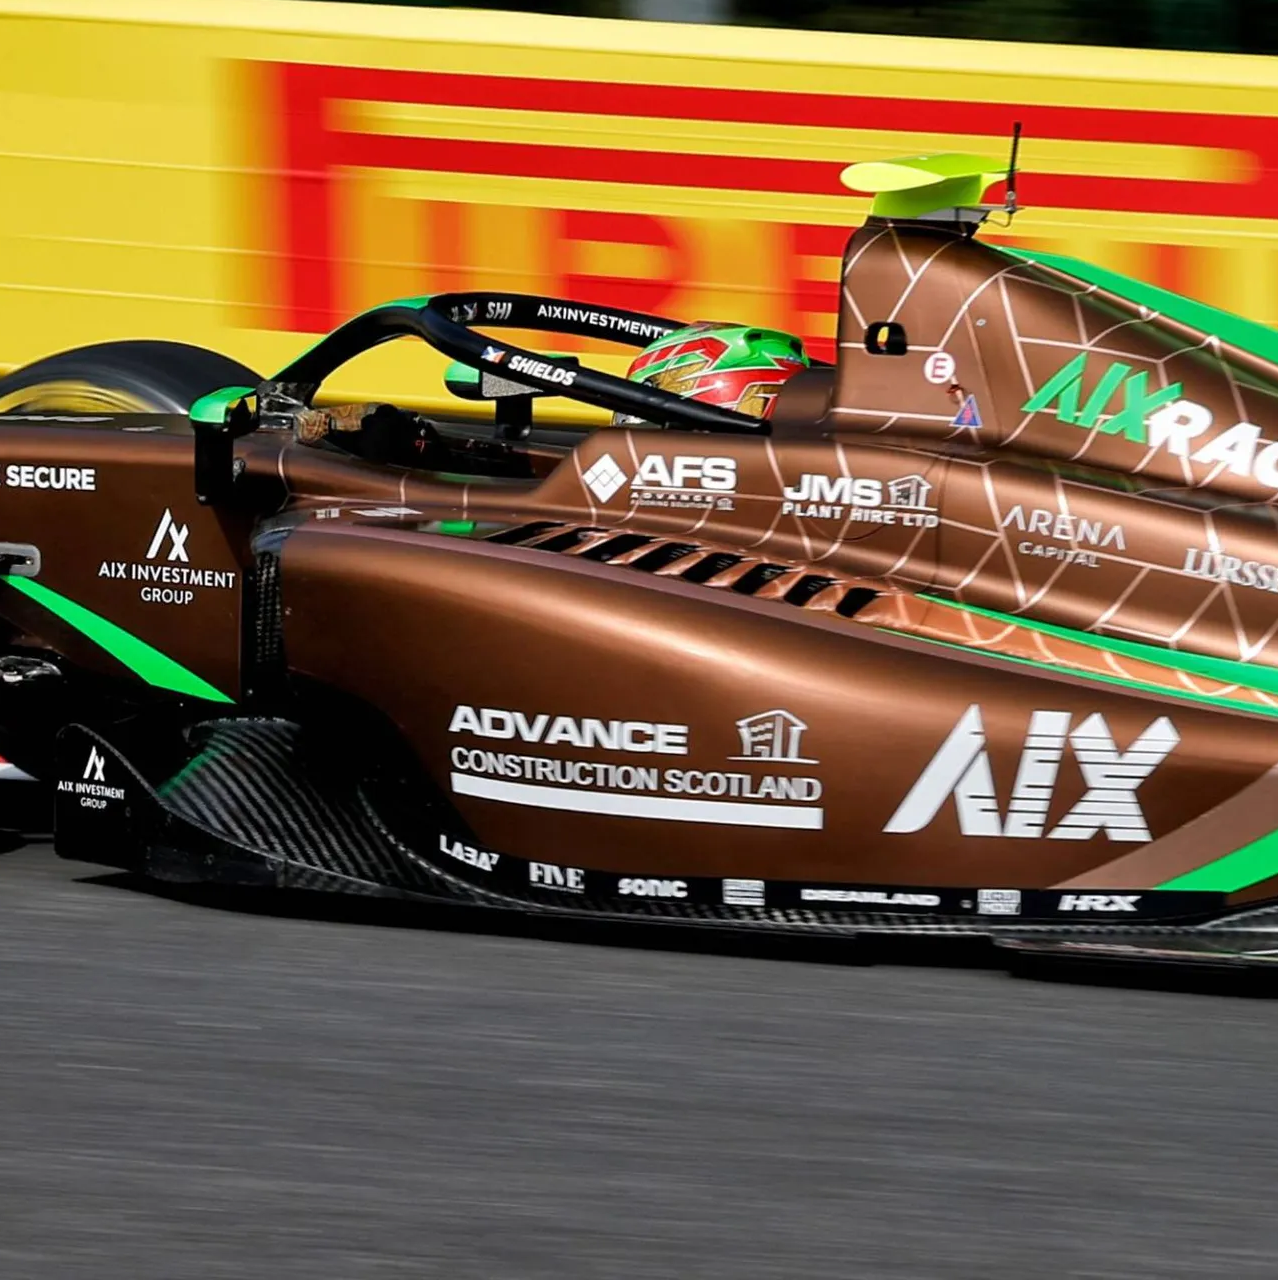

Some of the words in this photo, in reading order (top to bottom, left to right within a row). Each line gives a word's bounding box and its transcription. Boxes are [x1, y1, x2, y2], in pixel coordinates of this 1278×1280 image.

[508, 355, 577, 386] SHIELDS
[6, 465, 96, 491] SECURE
[631, 454, 737, 490] AFS
[783, 474, 883, 507] JMS
[782, 502, 844, 520] PLANT
[850, 508, 897, 525] HIRE
[902, 513, 940, 529] LTD
[1002, 504, 1127, 550] ARENA
[1018, 541, 1101, 568] CAPITAL
[98, 561, 126, 580] AIX
[132, 564, 235, 589] INVESTMENT
[141, 587, 193, 605] GROUP
[449, 705, 689, 754] ADVANCE
[451, 746, 658, 791] CONSTRUCTION
[664, 769, 822, 801] SCOTLAND
[882, 704, 1181, 842] AIX
[57, 780, 74, 792] AIX
[75, 782, 125, 800] INVESTMENT
[80, 797, 107, 809] GROUP
[529, 862, 585, 889] FIVE
[1058, 894, 1142, 911] HRX
